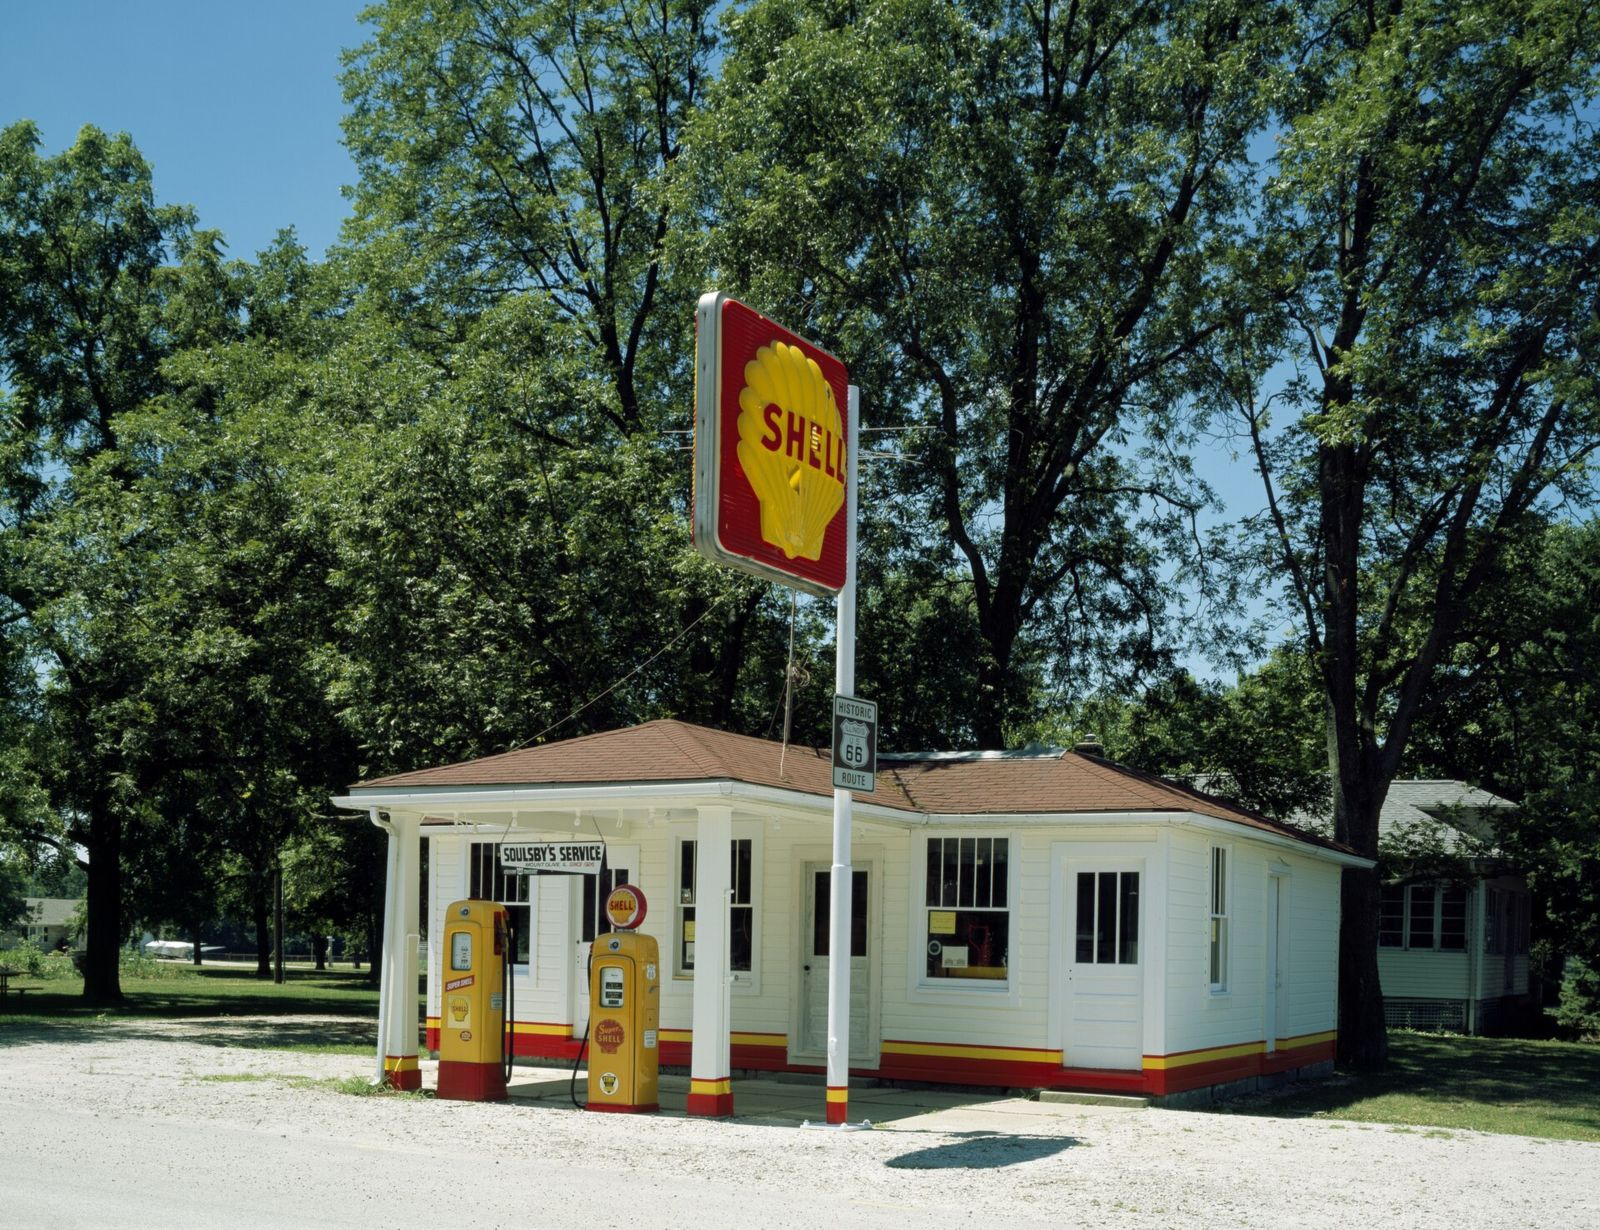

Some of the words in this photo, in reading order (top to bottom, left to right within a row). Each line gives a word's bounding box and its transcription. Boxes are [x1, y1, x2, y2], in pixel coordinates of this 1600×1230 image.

[761, 403, 845, 485] SHELL
[838, 702, 872, 719] HISTORIC
[846, 744, 863, 763] 66
[841, 772, 866, 786] ROUTE
[503, 844, 557, 862] SOULSBY'S
[559, 846, 602, 861] SERVICE
[609, 900, 634, 911] SHELL
[598, 1034, 620, 1043] SHELL
